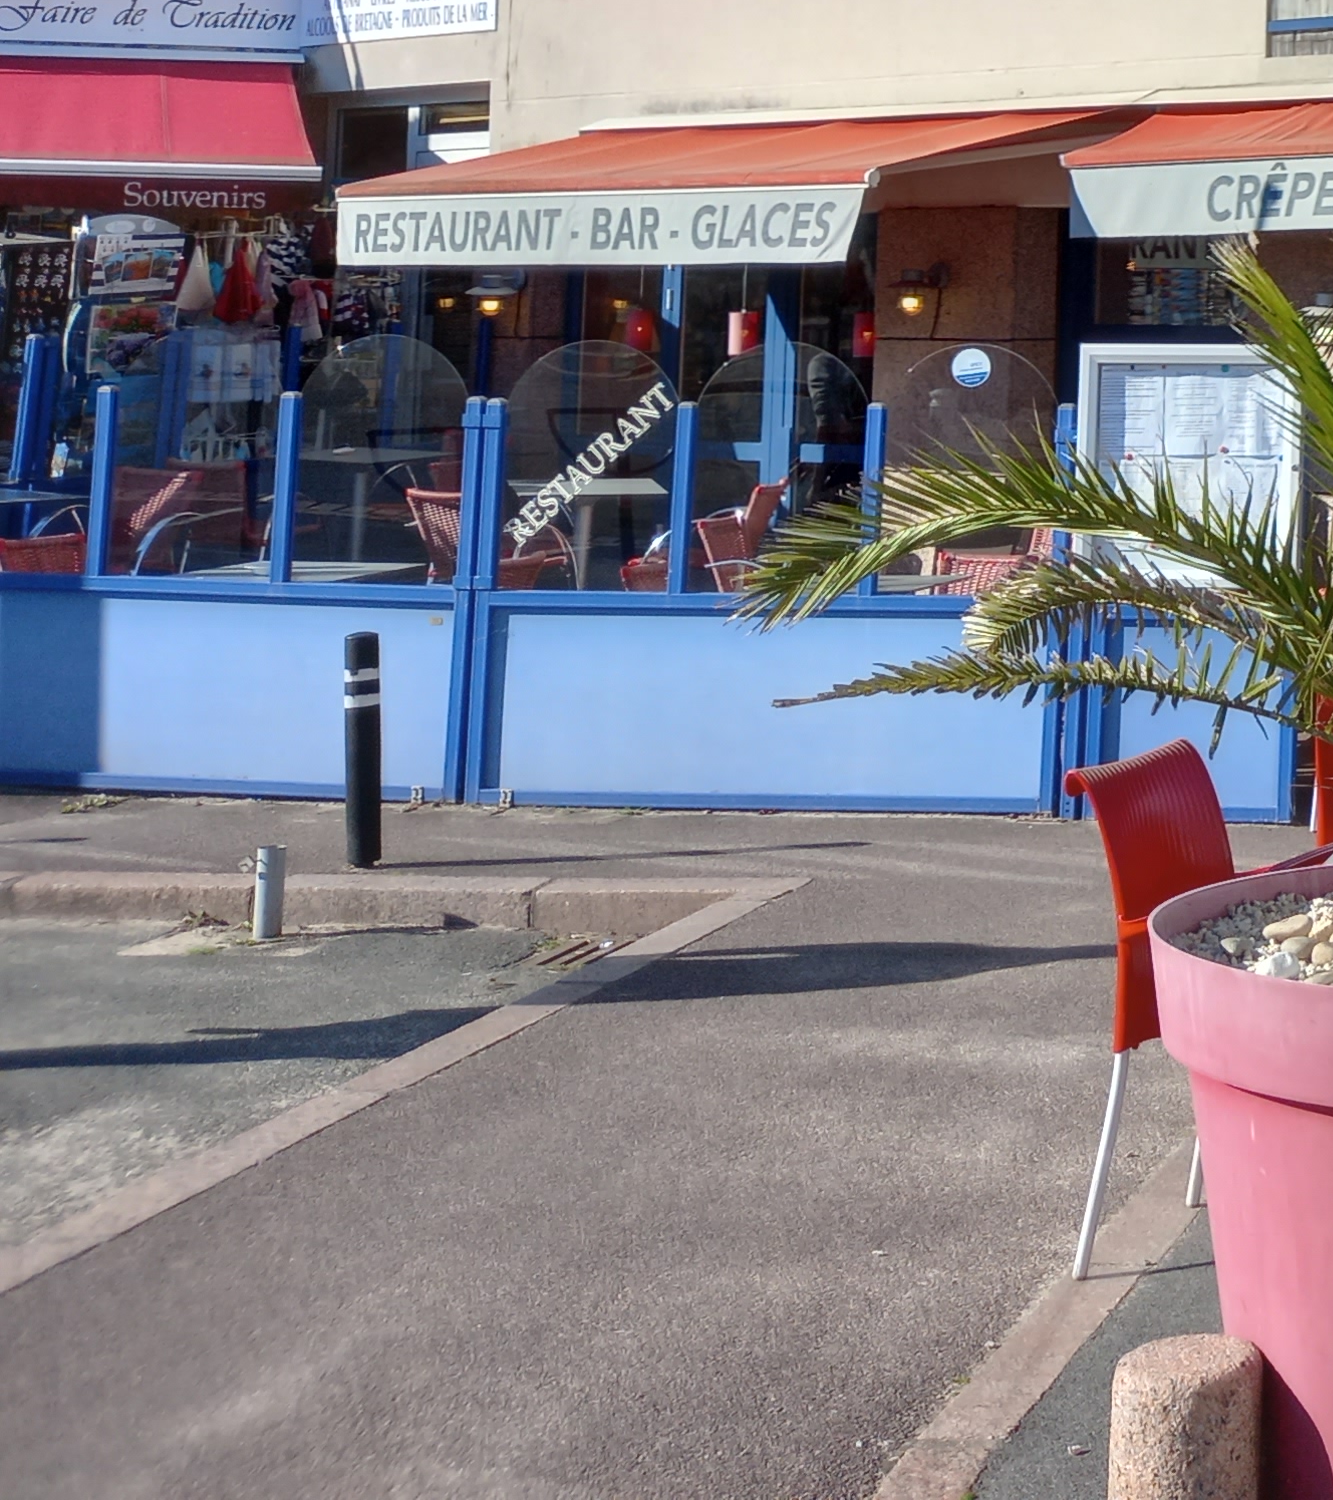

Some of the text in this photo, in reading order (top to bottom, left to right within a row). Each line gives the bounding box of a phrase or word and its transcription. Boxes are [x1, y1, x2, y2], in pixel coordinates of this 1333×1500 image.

[113, 0, 148, 26] de
[355, 11, 393, 32] BRETAGNE
[402, 6, 440, 28] PRODUITS
[444, 5, 455, 24] DE
[457, 4, 467, 23] LA
[470, 2, 488, 21] MER
[123, 182, 266, 209] Souvenirs
[354, 208, 562, 253] RESTAURANT
[590, 206, 660, 251] BAR
[692, 202, 836, 249] GLACES
[503, 382, 675, 547] RESTAURANT
